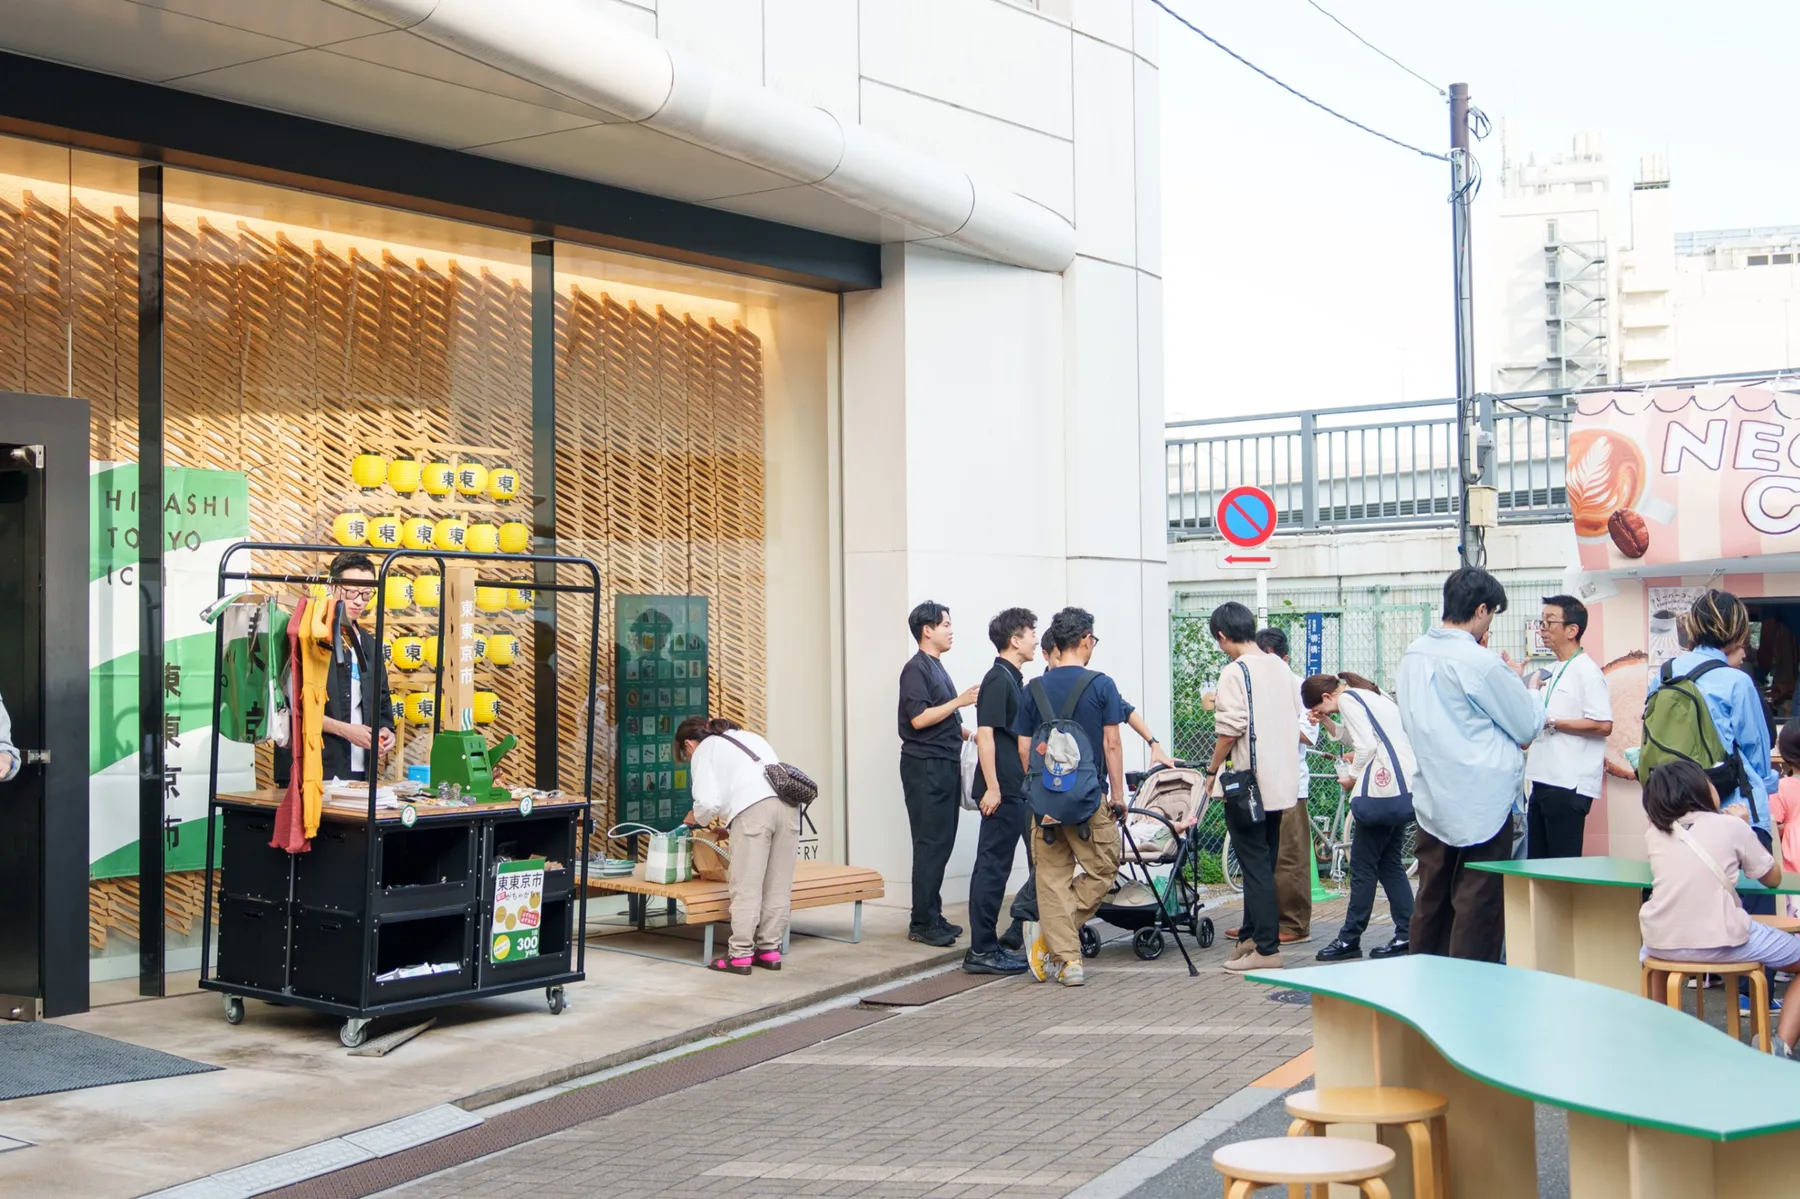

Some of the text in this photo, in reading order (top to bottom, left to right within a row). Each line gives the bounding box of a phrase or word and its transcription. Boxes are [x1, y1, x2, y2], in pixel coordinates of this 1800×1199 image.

[1661, 418, 1800, 474] NE
[458, 469, 476, 488] 東
[497, 474, 514, 492] 東
[105, 489, 229, 517] HIASHI
[107, 527, 201, 551] TOYO
[348, 520, 365, 539] 東
[378, 523, 396, 543] 東
[416, 524, 433, 544] 東
[449, 526, 465, 545] 東
[460, 600, 474, 685] 東東京市
[405, 643, 421, 662] 東
[417, 699, 433, 718] 東
[497, 872, 543, 892] 東東京市
[516, 935, 538, 951] 300
